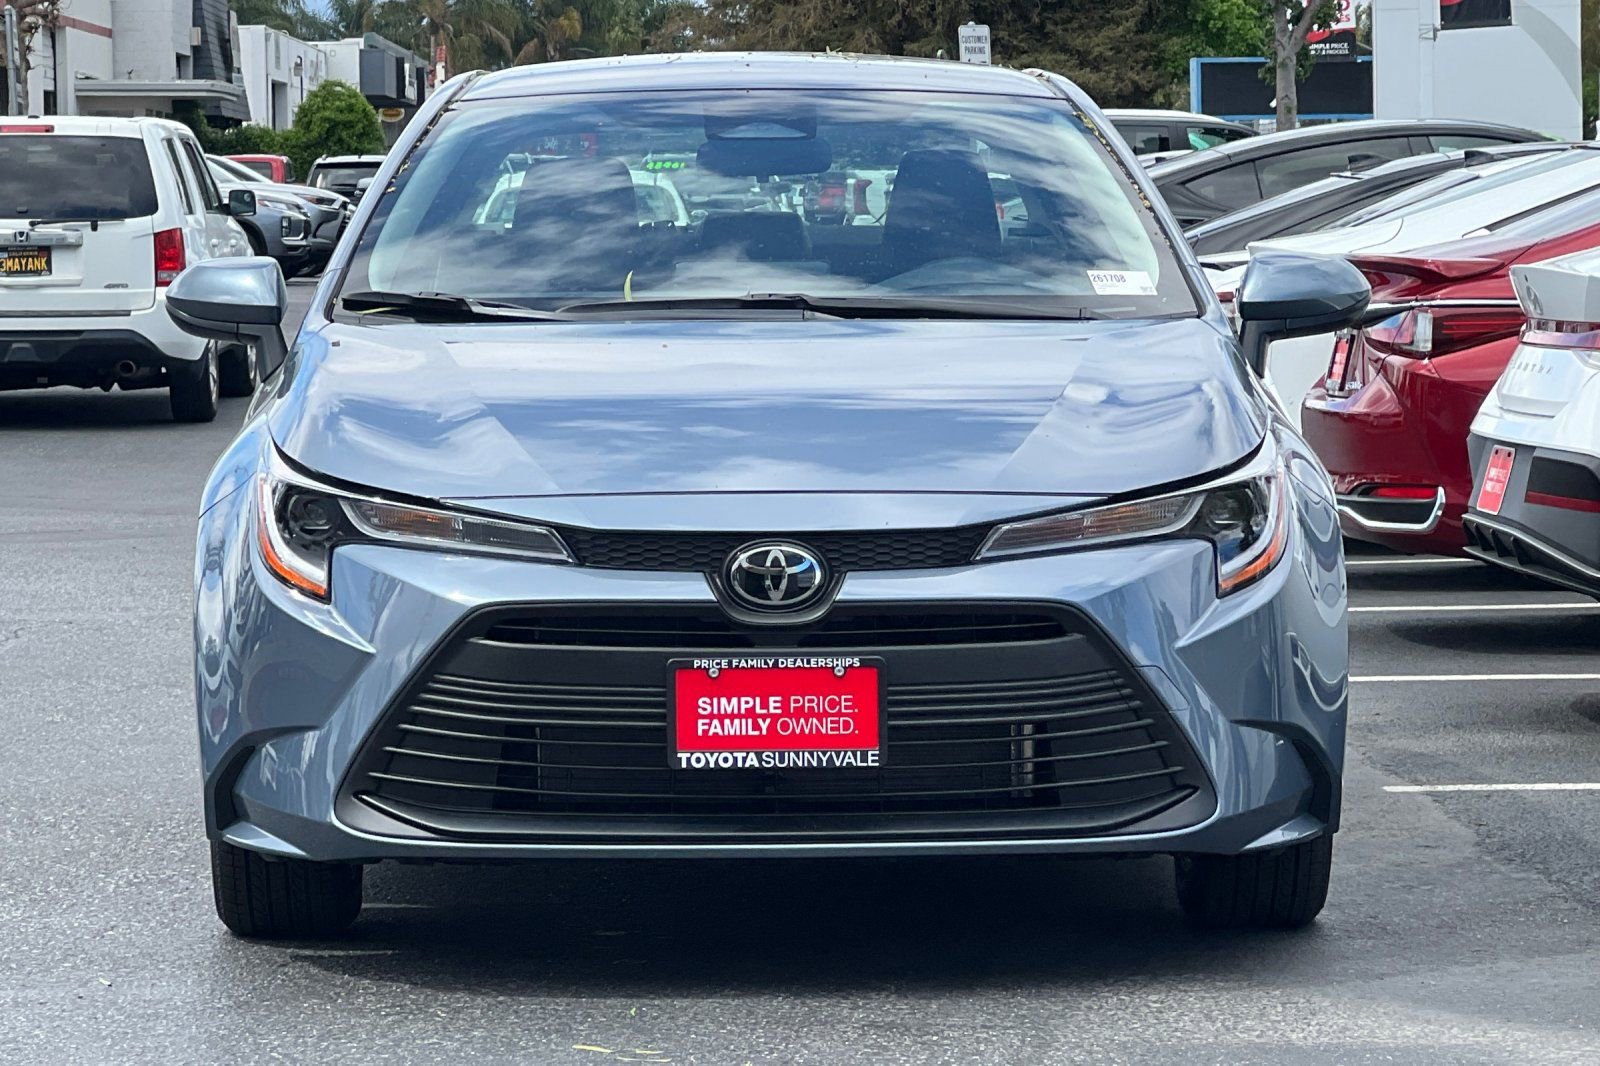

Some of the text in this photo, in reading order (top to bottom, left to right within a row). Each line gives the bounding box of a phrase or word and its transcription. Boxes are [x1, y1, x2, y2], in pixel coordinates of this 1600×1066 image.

[961, 35, 988, 44] CUSTOMER
[964, 46, 986, 55] PARKING
[1090, 273, 1127, 283] 261708
[693, 658, 860, 669] PRICE FAMILY DEALERSHIPS
[697, 695, 858, 714] SIMPLE PRICE.
[697, 717, 859, 736] FAMILY OWNED.
[677, 751, 880, 768] TOYOTA SUNNYVALE
